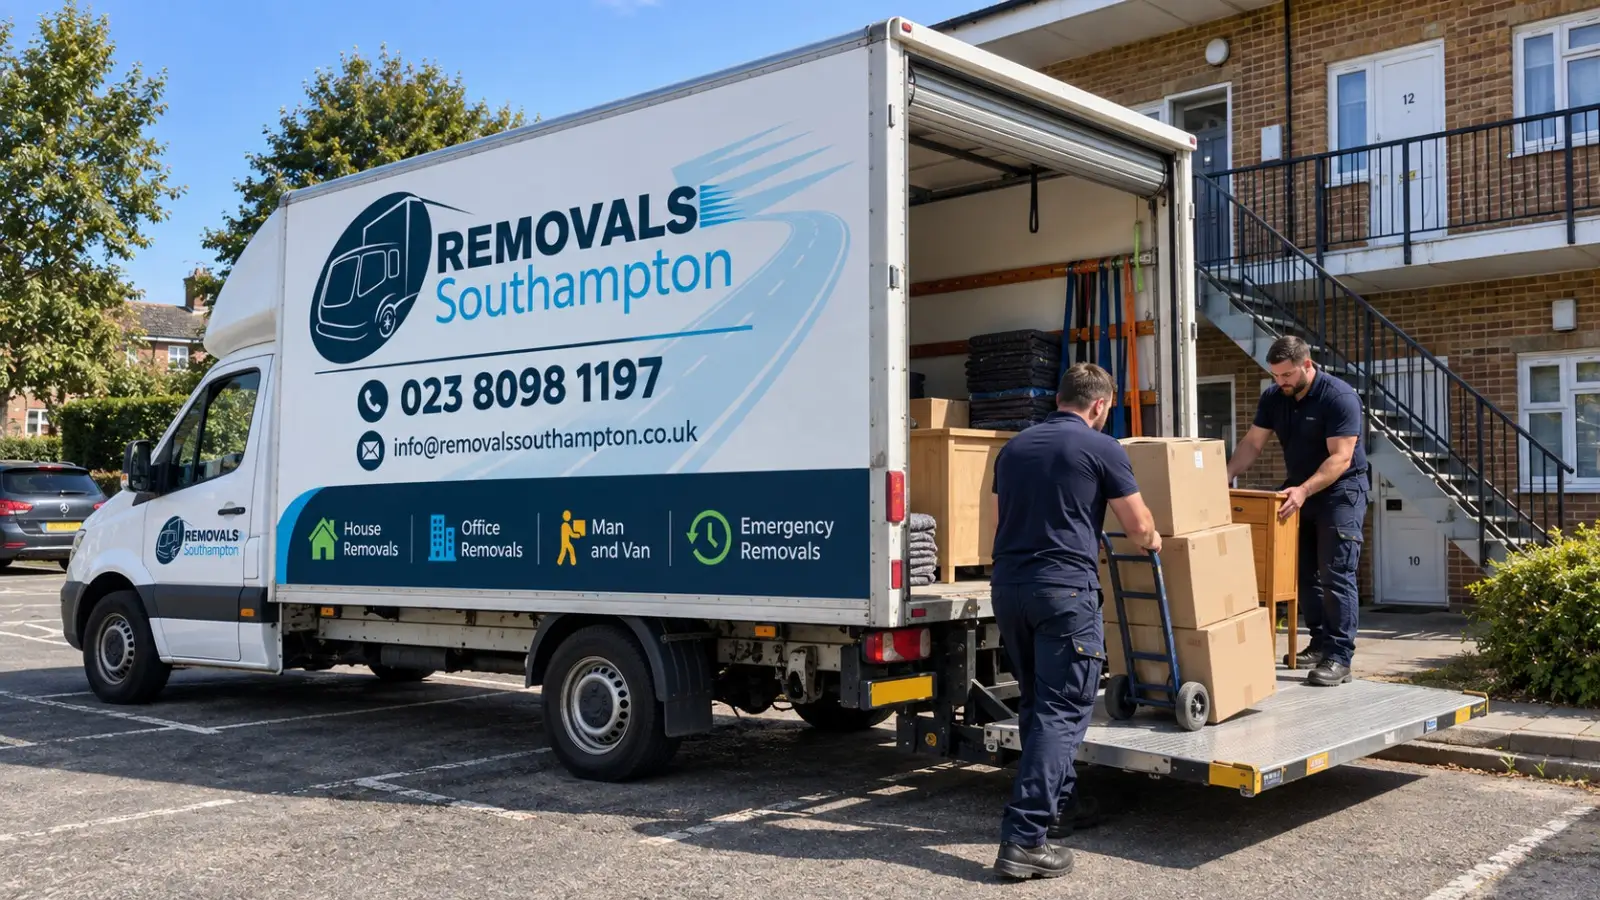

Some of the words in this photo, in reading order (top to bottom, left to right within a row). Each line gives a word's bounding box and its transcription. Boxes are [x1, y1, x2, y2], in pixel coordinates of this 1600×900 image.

[1403, 92, 1415, 105] 12
[436, 185, 699, 274] REMOVALS
[436, 248, 732, 324] Southampton
[401, 374, 463, 416] 023
[473, 364, 566, 411] 8098
[576, 356, 663, 403] 1197
[393, 419, 698, 459] info@removalssouthampton.co.uk
[344, 521, 382, 537] House
[461, 519, 501, 536] Office
[591, 518, 624, 535] Man
[740, 516, 834, 540] Emergency
[185, 529, 239, 542] REMOVALS
[183, 543, 240, 558] Southampton
[343, 541, 399, 557] Removals
[461, 541, 523, 558] Removals
[591, 541, 618, 559] and
[622, 542, 651, 559] Van
[740, 541, 821, 560] Removals
[1408, 556, 1420, 566] 10
